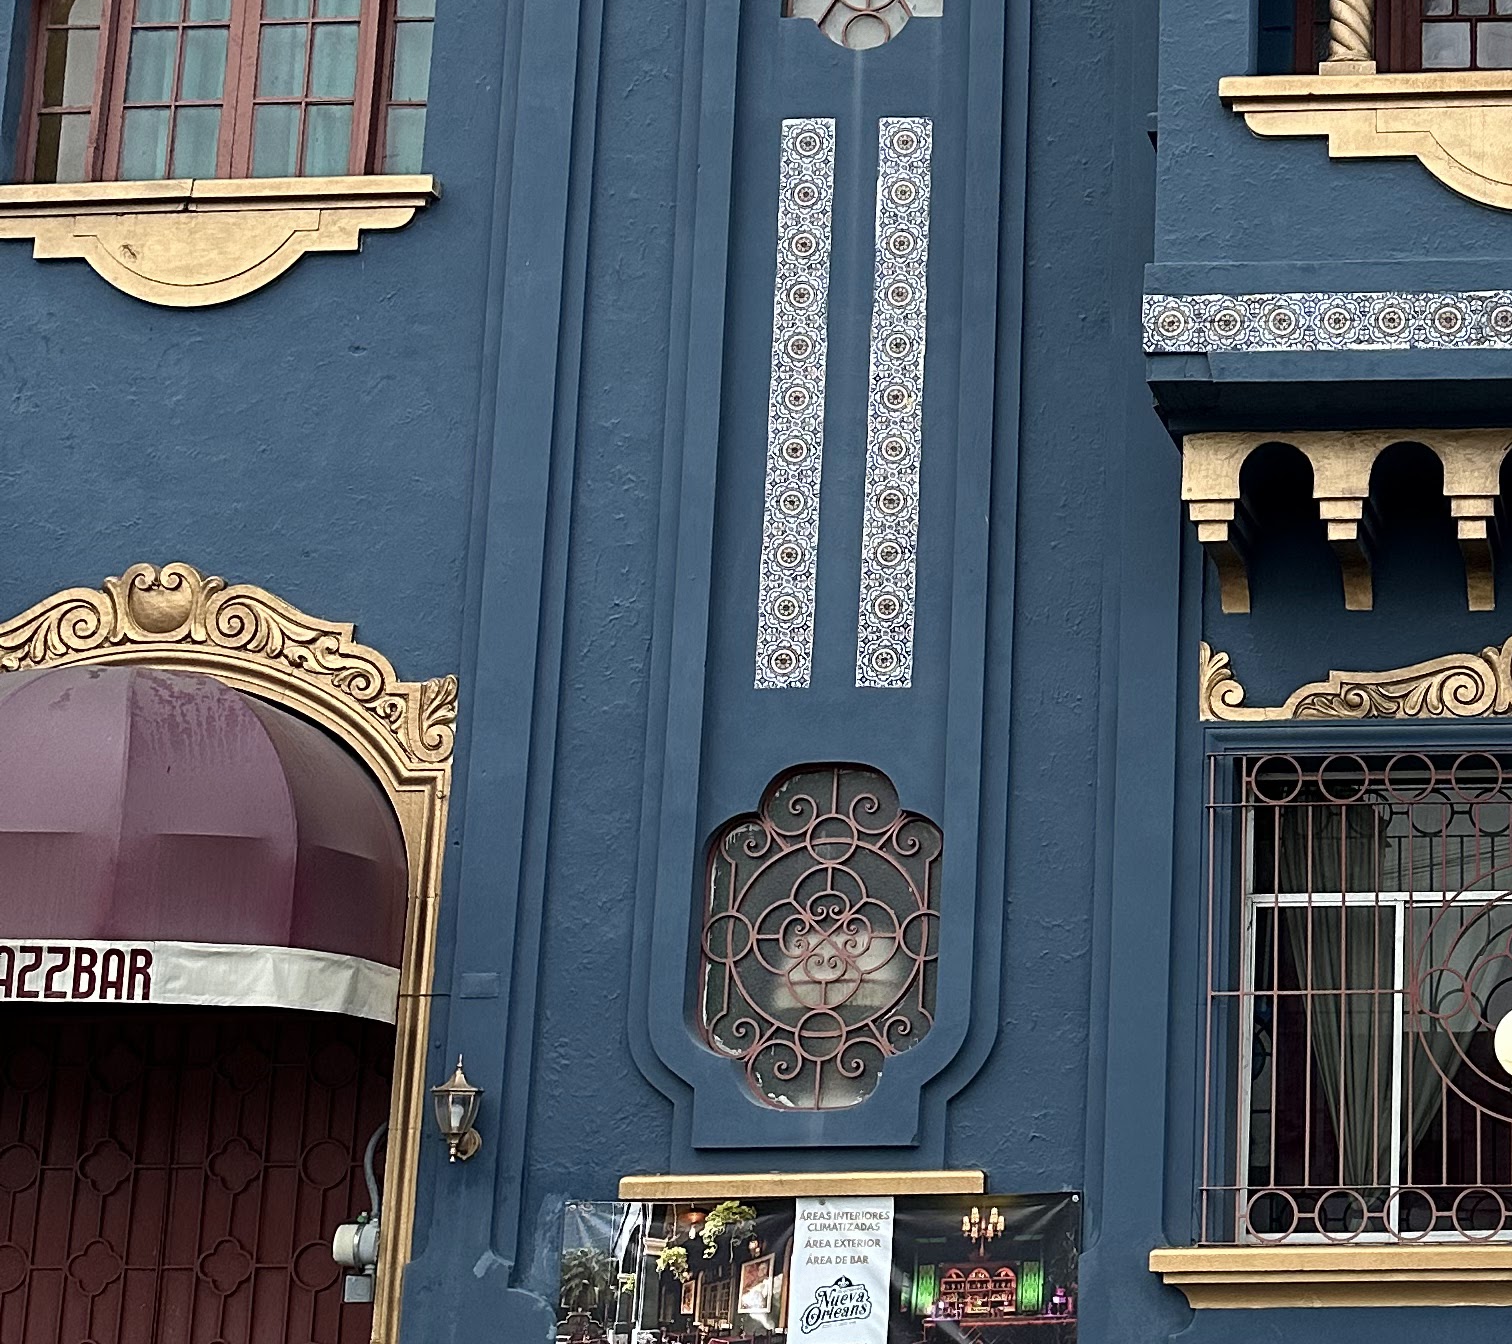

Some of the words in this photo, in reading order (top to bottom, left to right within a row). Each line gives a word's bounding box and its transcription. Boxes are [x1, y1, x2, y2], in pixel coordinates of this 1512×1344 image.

[799, 1209, 831, 1221] ÁREAS
[833, 1211, 890, 1221] INTERIORES
[807, 1222, 881, 1232] CLIMATIZADAS
[804, 1236, 832, 1249] ÁREA
[834, 1238, 881, 1248] EXTERIOR
[805, 1253, 833, 1266] ÁREA
[835, 1255, 848, 1264] DE
[850, 1255, 869, 1265] BAR
[817, 1289, 865, 1307] Nueva
[805, 1303, 867, 1327] Orleans
